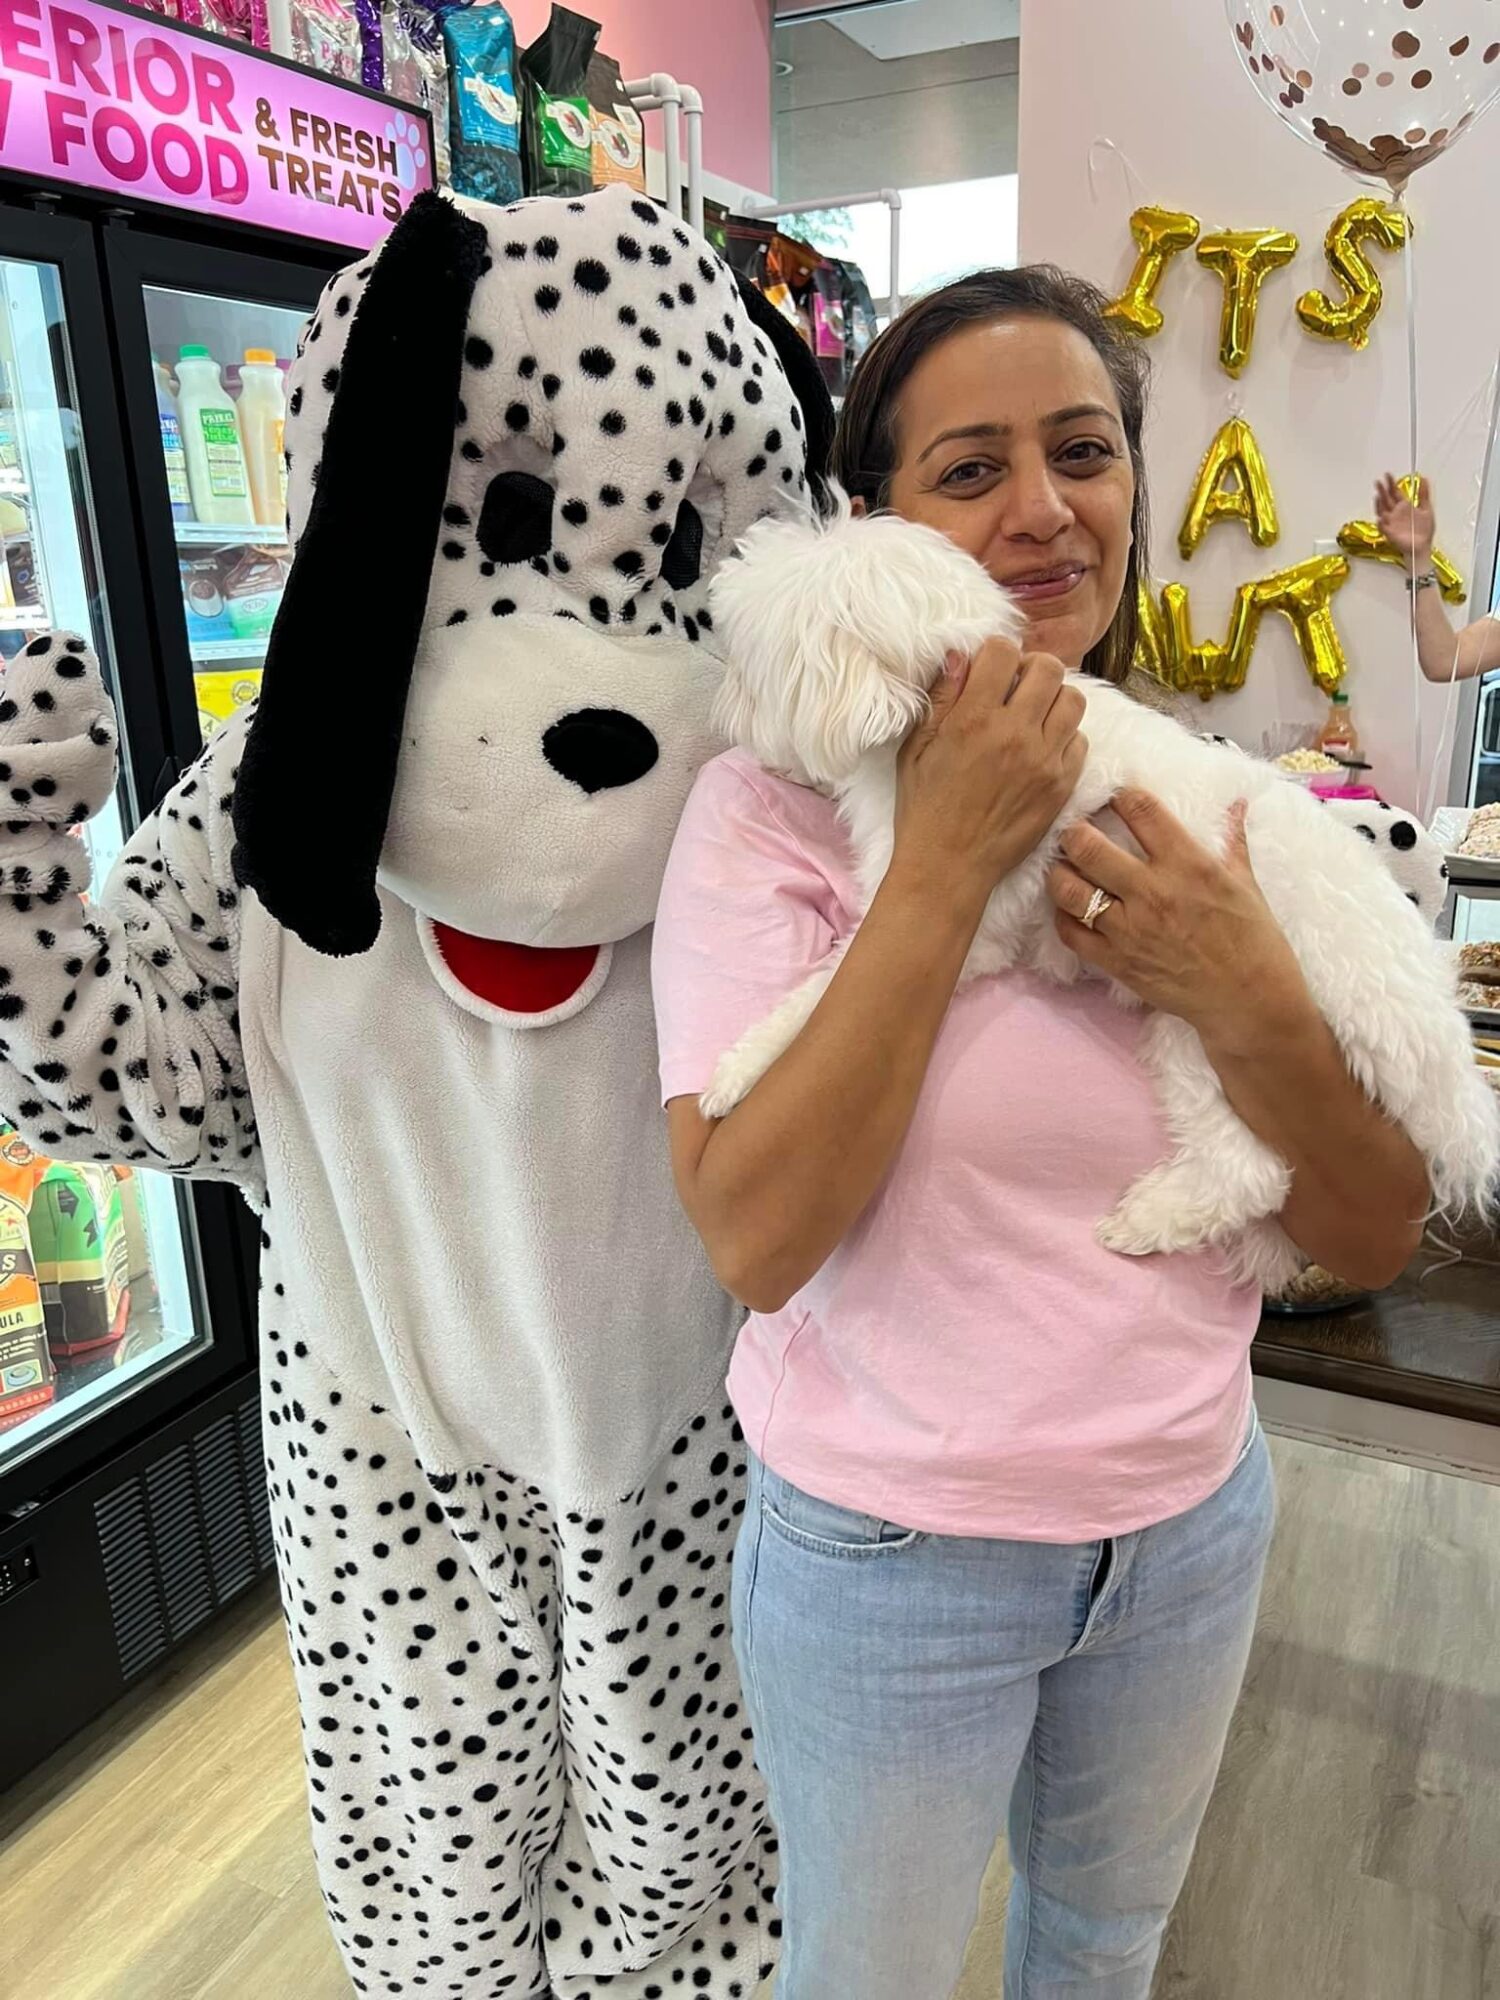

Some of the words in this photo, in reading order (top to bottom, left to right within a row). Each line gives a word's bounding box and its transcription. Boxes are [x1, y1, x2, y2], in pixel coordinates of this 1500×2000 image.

[45, 90, 249, 206] FOOD
[255, 97, 281, 141] &
[290, 107, 398, 177] FRESH
[257, 144, 402, 223] TREATS
[1101, 195, 1414, 380] ITS
[1178, 415, 1279, 562] A
